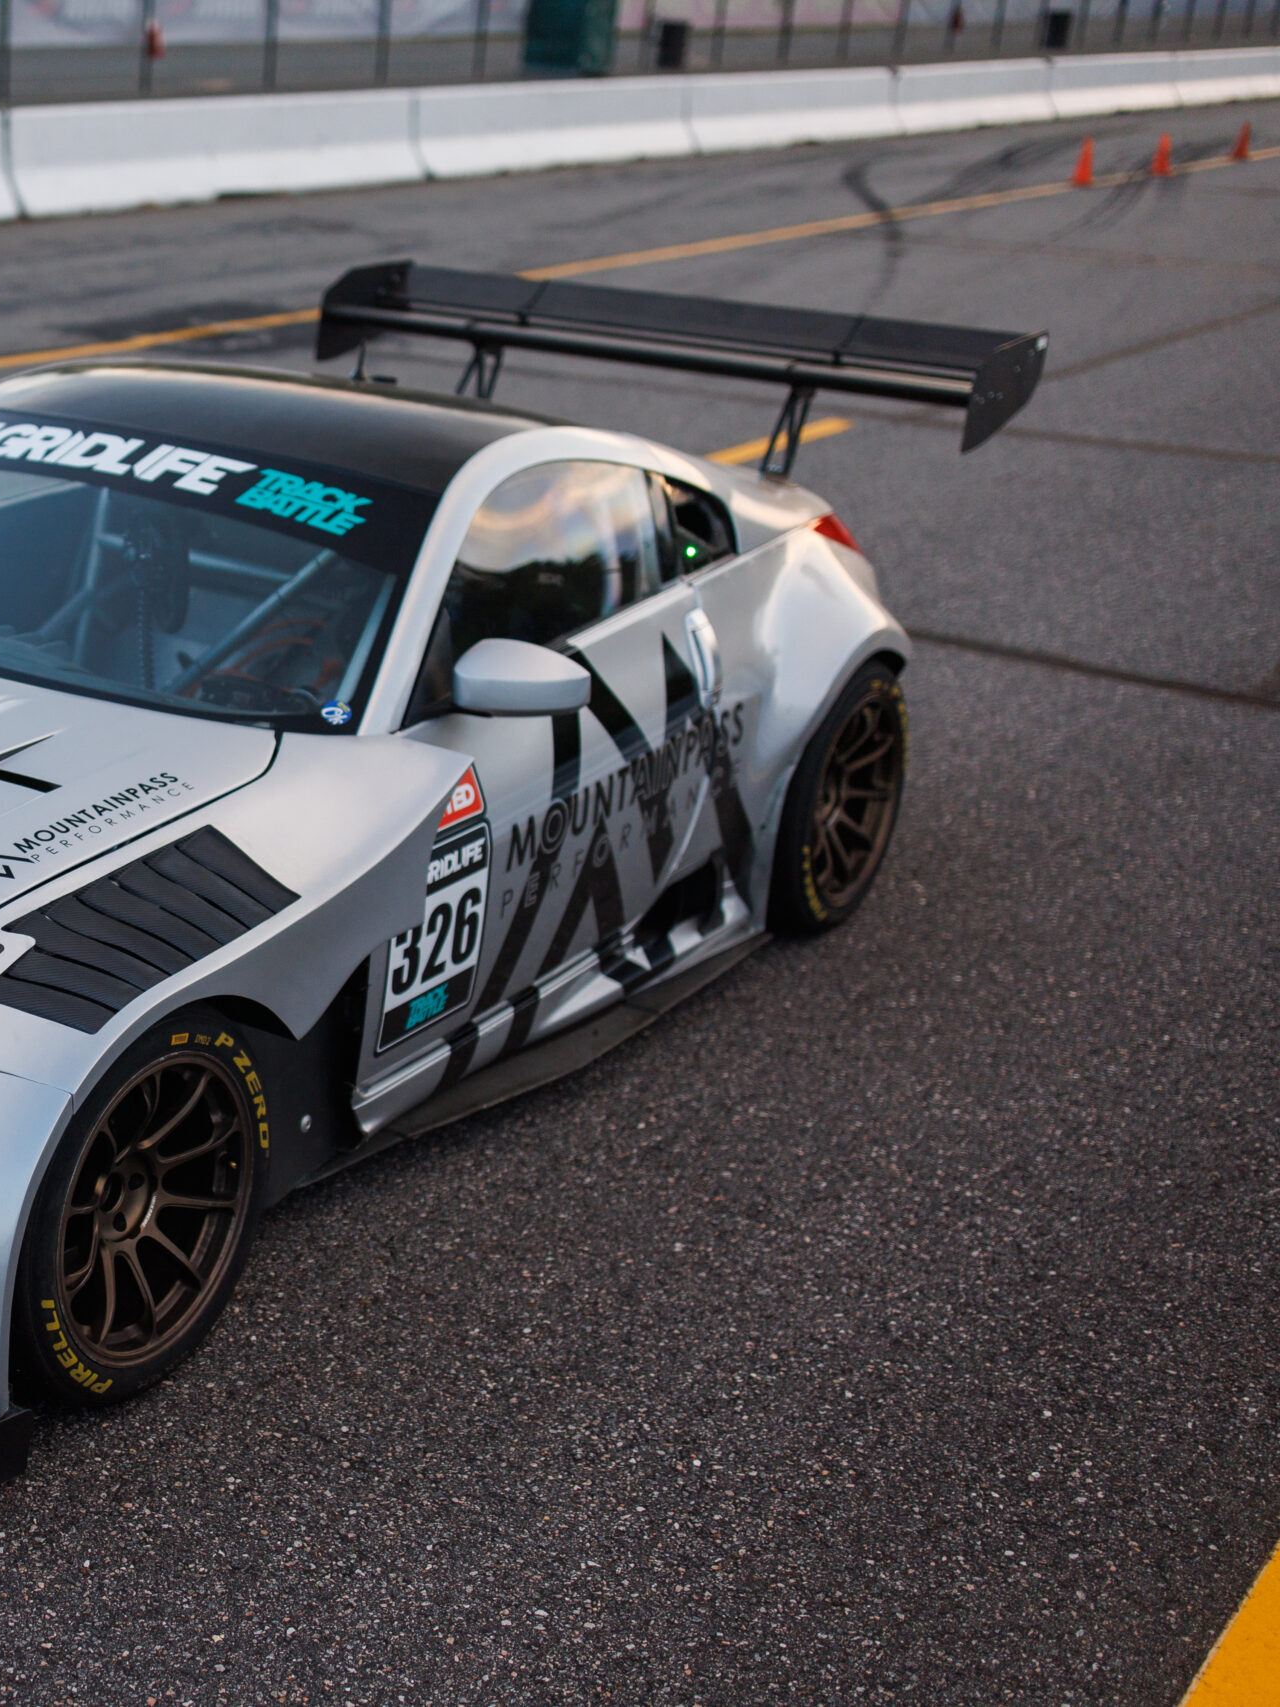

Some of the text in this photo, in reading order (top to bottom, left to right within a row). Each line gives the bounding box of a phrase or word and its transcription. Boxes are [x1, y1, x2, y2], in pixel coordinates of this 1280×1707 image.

[234, 487, 367, 536] BATTLE
[255, 468, 373, 514] TRACK
[12, 771, 179, 854] MOUNTAINPASS
[30, 781, 195, 864] PERFORMANCE
[506, 701, 744, 873] MOUNTAINPASS
[426, 837, 486, 884] RIDLIFE
[391, 887, 482, 996] 326
[214, 1031, 269, 1149] P ZERO
[40, 1299, 113, 1394] PIRELLI
